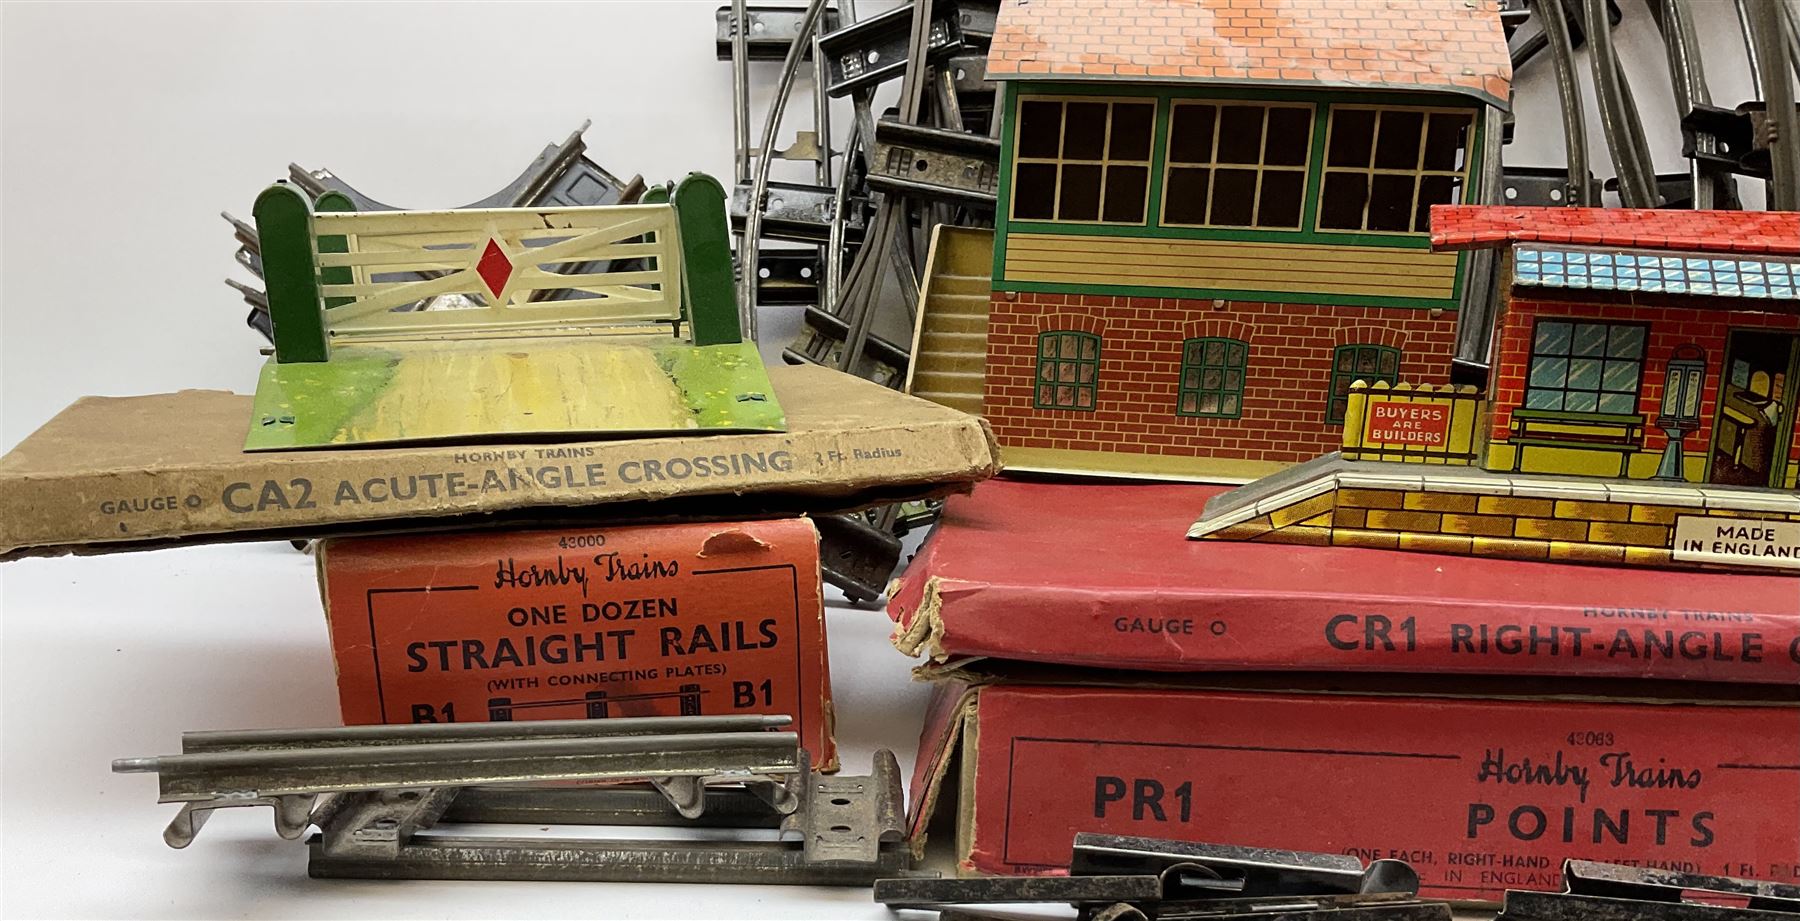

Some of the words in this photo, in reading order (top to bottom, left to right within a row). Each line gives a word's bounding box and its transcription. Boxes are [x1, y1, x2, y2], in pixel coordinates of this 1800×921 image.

[1376, 406, 1442, 421] BUYERS
[1392, 420, 1421, 430] ARE
[1372, 429, 1441, 443] BUILDERS
[454, 451, 527, 465] HORNBY
[534, 446, 594, 460] TRAINS
[853, 447, 902, 460] Radius
[100, 495, 178, 515] GAUGE
[221, 478, 317, 513] CA2
[334, 462, 607, 506] ACUTE-ANGLE
[618, 450, 793, 484] CROSSING
[558, 534, 605, 549] 43000
[1683, 540, 1703, 552] IN
[1717, 526, 1775, 541] MADE
[494, 556, 587, 599] Hornby
[594, 553, 679, 584] Trains
[507, 605, 566, 627] ONE
[582, 598, 678, 620] DOZEN
[1583, 606, 1669, 620] HORNBY
[1682, 609, 1754, 622] TRAINS
[407, 629, 636, 674] STRAIGHT
[660, 618, 779, 657] RAILS
[1114, 617, 1194, 634] GAUGE
[1324, 613, 1417, 652] CR1
[1450, 622, 1764, 664] RIGHT-ANGLE
[487, 677, 539, 693] (WITH
[547, 667, 657, 687] CONNECTING
[665, 662, 727, 679] PLATES)
[733, 679, 774, 708] B1
[1477, 748, 1590, 804] Hornby
[1600, 752, 1703, 790] Trains
[1094, 775, 1193, 823] PR1
[1466, 803, 1716, 848] POINTS
[1389, 849, 1439, 865] EACH,
[1447, 852, 1550, 868] RIGHT-HAND
[1723, 863, 1730, 876] 1
[1444, 870, 1463, 882] IN
